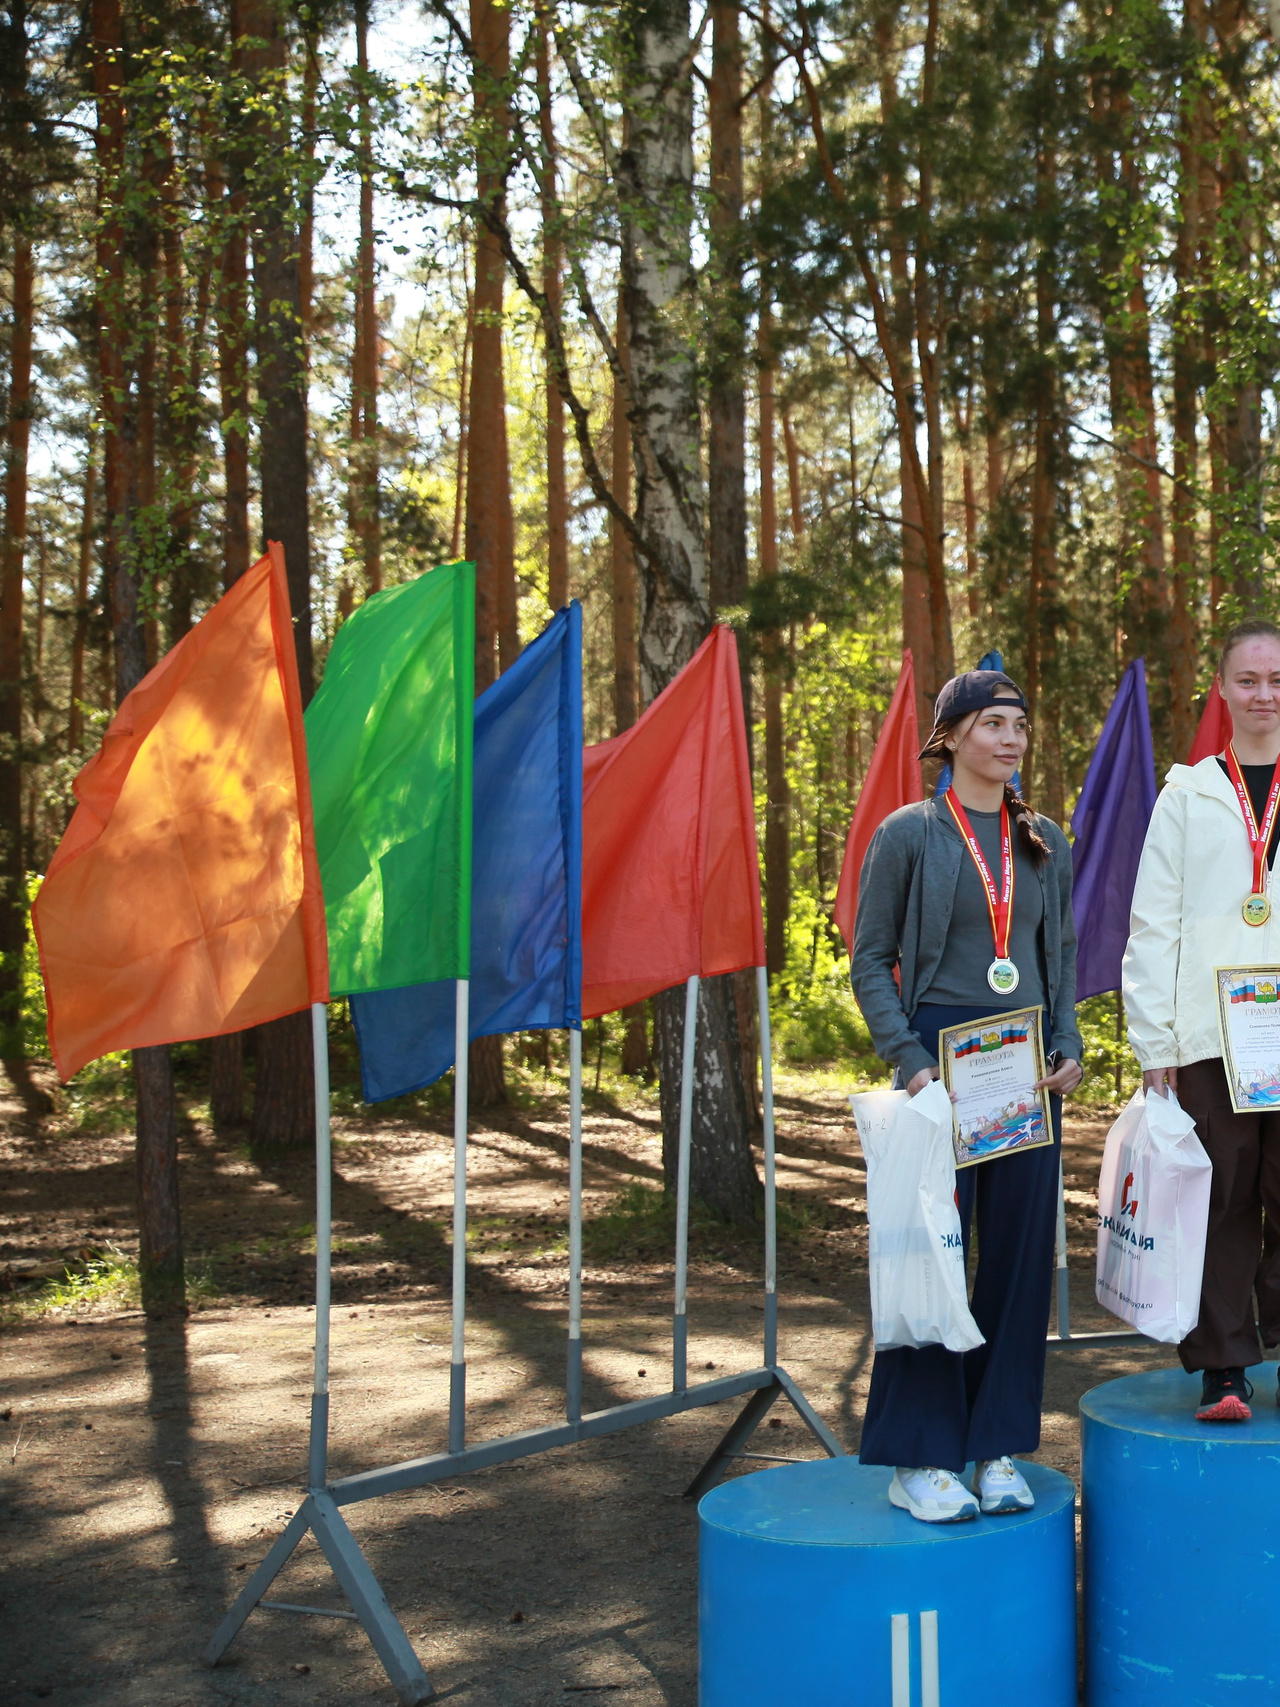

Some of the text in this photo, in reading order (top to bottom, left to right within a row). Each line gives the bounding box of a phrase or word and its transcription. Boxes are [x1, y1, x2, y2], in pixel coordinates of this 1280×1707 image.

[1236, 782, 1244, 792] лет
[1242, 800, 1251, 818] Марья
[1266, 800, 1276, 819] Марья
[1265, 819, 1272, 828] да
[1250, 825, 1258, 841] Иван
[1260, 827, 1269, 843] Иван
[968, 837, 979, 853] Иван
[980, 862, 991, 882] Марья
[988, 885, 996, 893] 15
[1004, 856, 1012, 876] Марья
[969, 1050, 1015, 1067] ГРАМОТА
